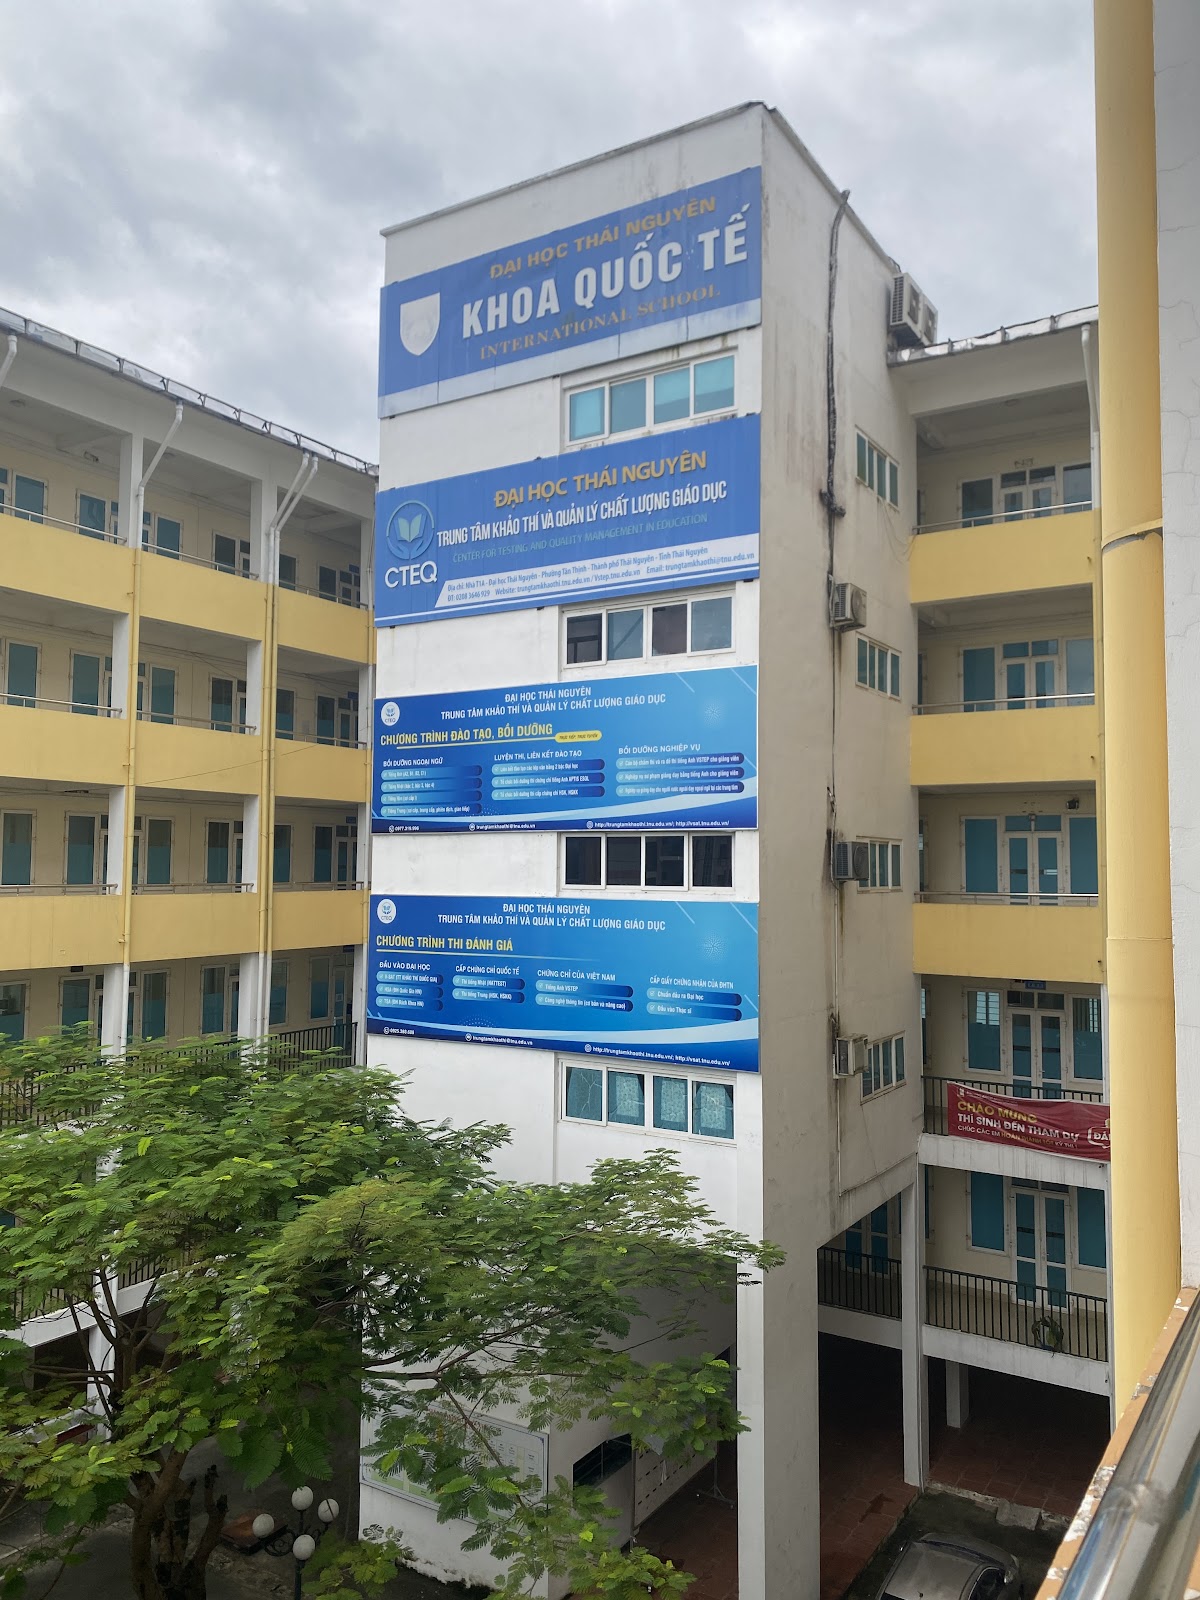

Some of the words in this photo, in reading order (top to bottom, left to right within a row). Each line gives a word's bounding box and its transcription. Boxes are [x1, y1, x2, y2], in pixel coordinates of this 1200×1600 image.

[490, 257, 522, 281] ĐẠI
[528, 243, 568, 265] HỌC
[574, 224, 619, 253] THÁI
[626, 196, 716, 237] NGUYÊN
[462, 278, 560, 340] KHOA
[575, 233, 683, 309] QUỐC
[699, 203, 750, 272] TẾ
[480, 307, 632, 360] INTERNATIONAL
[637, 284, 720, 317] SCHOOL
[494, 487, 524, 508] ĐẠI
[528, 477, 568, 503] HỌC
[573, 465, 617, 492] THÁI
[622, 450, 707, 483] NGUYÊN
[437, 528, 468, 547] TRUNG
[470, 522, 490, 542] TÂM
[492, 515, 520, 538] KHẢO
[522, 512, 539, 533] THÍ
[541, 509, 554, 530] VÀ
[556, 503, 584, 527] QUẢN
[587, 501, 598, 522] LÝ
[600, 493, 629, 519] CHẤT
[632, 491, 670, 514] LƯỢNG
[672, 483, 699, 507] GIÁO
[702, 480, 727, 503] DỤC
[453, 549, 480, 563] CENTER
[482, 547, 496, 558] FOR
[498, 544, 528, 556] TESTING
[530, 540, 547, 551] AND
[549, 533, 582, 548] QUALITY
[584, 524, 644, 542] MANAGEMENT
[646, 521, 655, 532] IN
[656, 513, 708, 530] EDUCATION
[384, 560, 438, 589] CTEQ
[507, 574, 518, 584] Thái
[518, 572, 538, 585] Nguyên
[633, 555, 654, 567] Nguyên
[685, 546, 708, 559] Nguyên
[495, 586, 517, 596] Website:
[646, 564, 665, 574] Email:
[505, 692, 518, 704] ĐẠI
[520, 691, 536, 704] HỌC
[538, 688, 556, 700] THÁI
[558, 685, 591, 698] NGUYÊN
[441, 709, 465, 720] TRUNG
[467, 706, 483, 718] TÂM
[485, 705, 505, 717] KHẢO
[507, 702, 520, 714] THÍ
[522, 701, 533, 713] VÀ
[534, 700, 556, 712] QUẢN
[558, 699, 568, 711] LÝ
[570, 697, 592, 709] CHẤT
[594, 696, 622, 709] LƯỢNG
[625, 693, 645, 706] GIÁO
[648, 693, 666, 706] DỤC
[380, 732, 418, 746] CHƯƠNG
[420, 729, 448, 743] TRÌNH
[450, 727, 471, 742] ĐÀO
[473, 727, 495, 743] TẠO,
[498, 722, 514, 738] BỒI
[517, 722, 553, 737] DƯỠNG
[494, 752, 513, 762] LUYỆN
[632, 743, 658, 754] DƯỠNG
[660, 742, 689, 754] NGHIỆP
[690, 743, 701, 753] VỤ
[503, 903, 516, 914] ĐẠI
[518, 903, 534, 914] HỌC
[536, 902, 555, 914] THÁI
[557, 903, 591, 915] NGUYÊN
[438, 914, 463, 924] TRUNG
[465, 913, 481, 924] TÂM
[483, 913, 503, 925] KHẢO
[506, 913, 518, 925] THÍ
[520, 914, 531, 926] VÀ
[532, 914, 555, 927] QUẢN
[557, 915, 567, 927] LÝ
[569, 915, 591, 928] CHẤT
[593, 917, 621, 930] LƯỢNG
[624, 918, 645, 930] GIÁO
[648, 920, 666, 932] DỤC
[376, 934, 414, 948] CHƯƠNG
[417, 935, 445, 949] TRÌNH
[448, 938, 463, 950] THI
[466, 936, 493, 951] ĐÁNH
[496, 937, 513, 951] GIÁ
[393, 961, 405, 970] VÀO
[417, 963, 431, 972] HỌC
[496, 966, 511, 975] QUỐC
[537, 968, 559, 978] CHỨNG
[560, 969, 571, 979] CHỈ
[572, 969, 585, 980] CỦA
[586, 972, 600, 982] VIỆT
[601, 973, 616, 982] NAM
[719, 981, 734, 989] ĐHTN
[976, 1116, 1001, 1128] SINH
[1028, 1125, 1059, 1138] THAM
